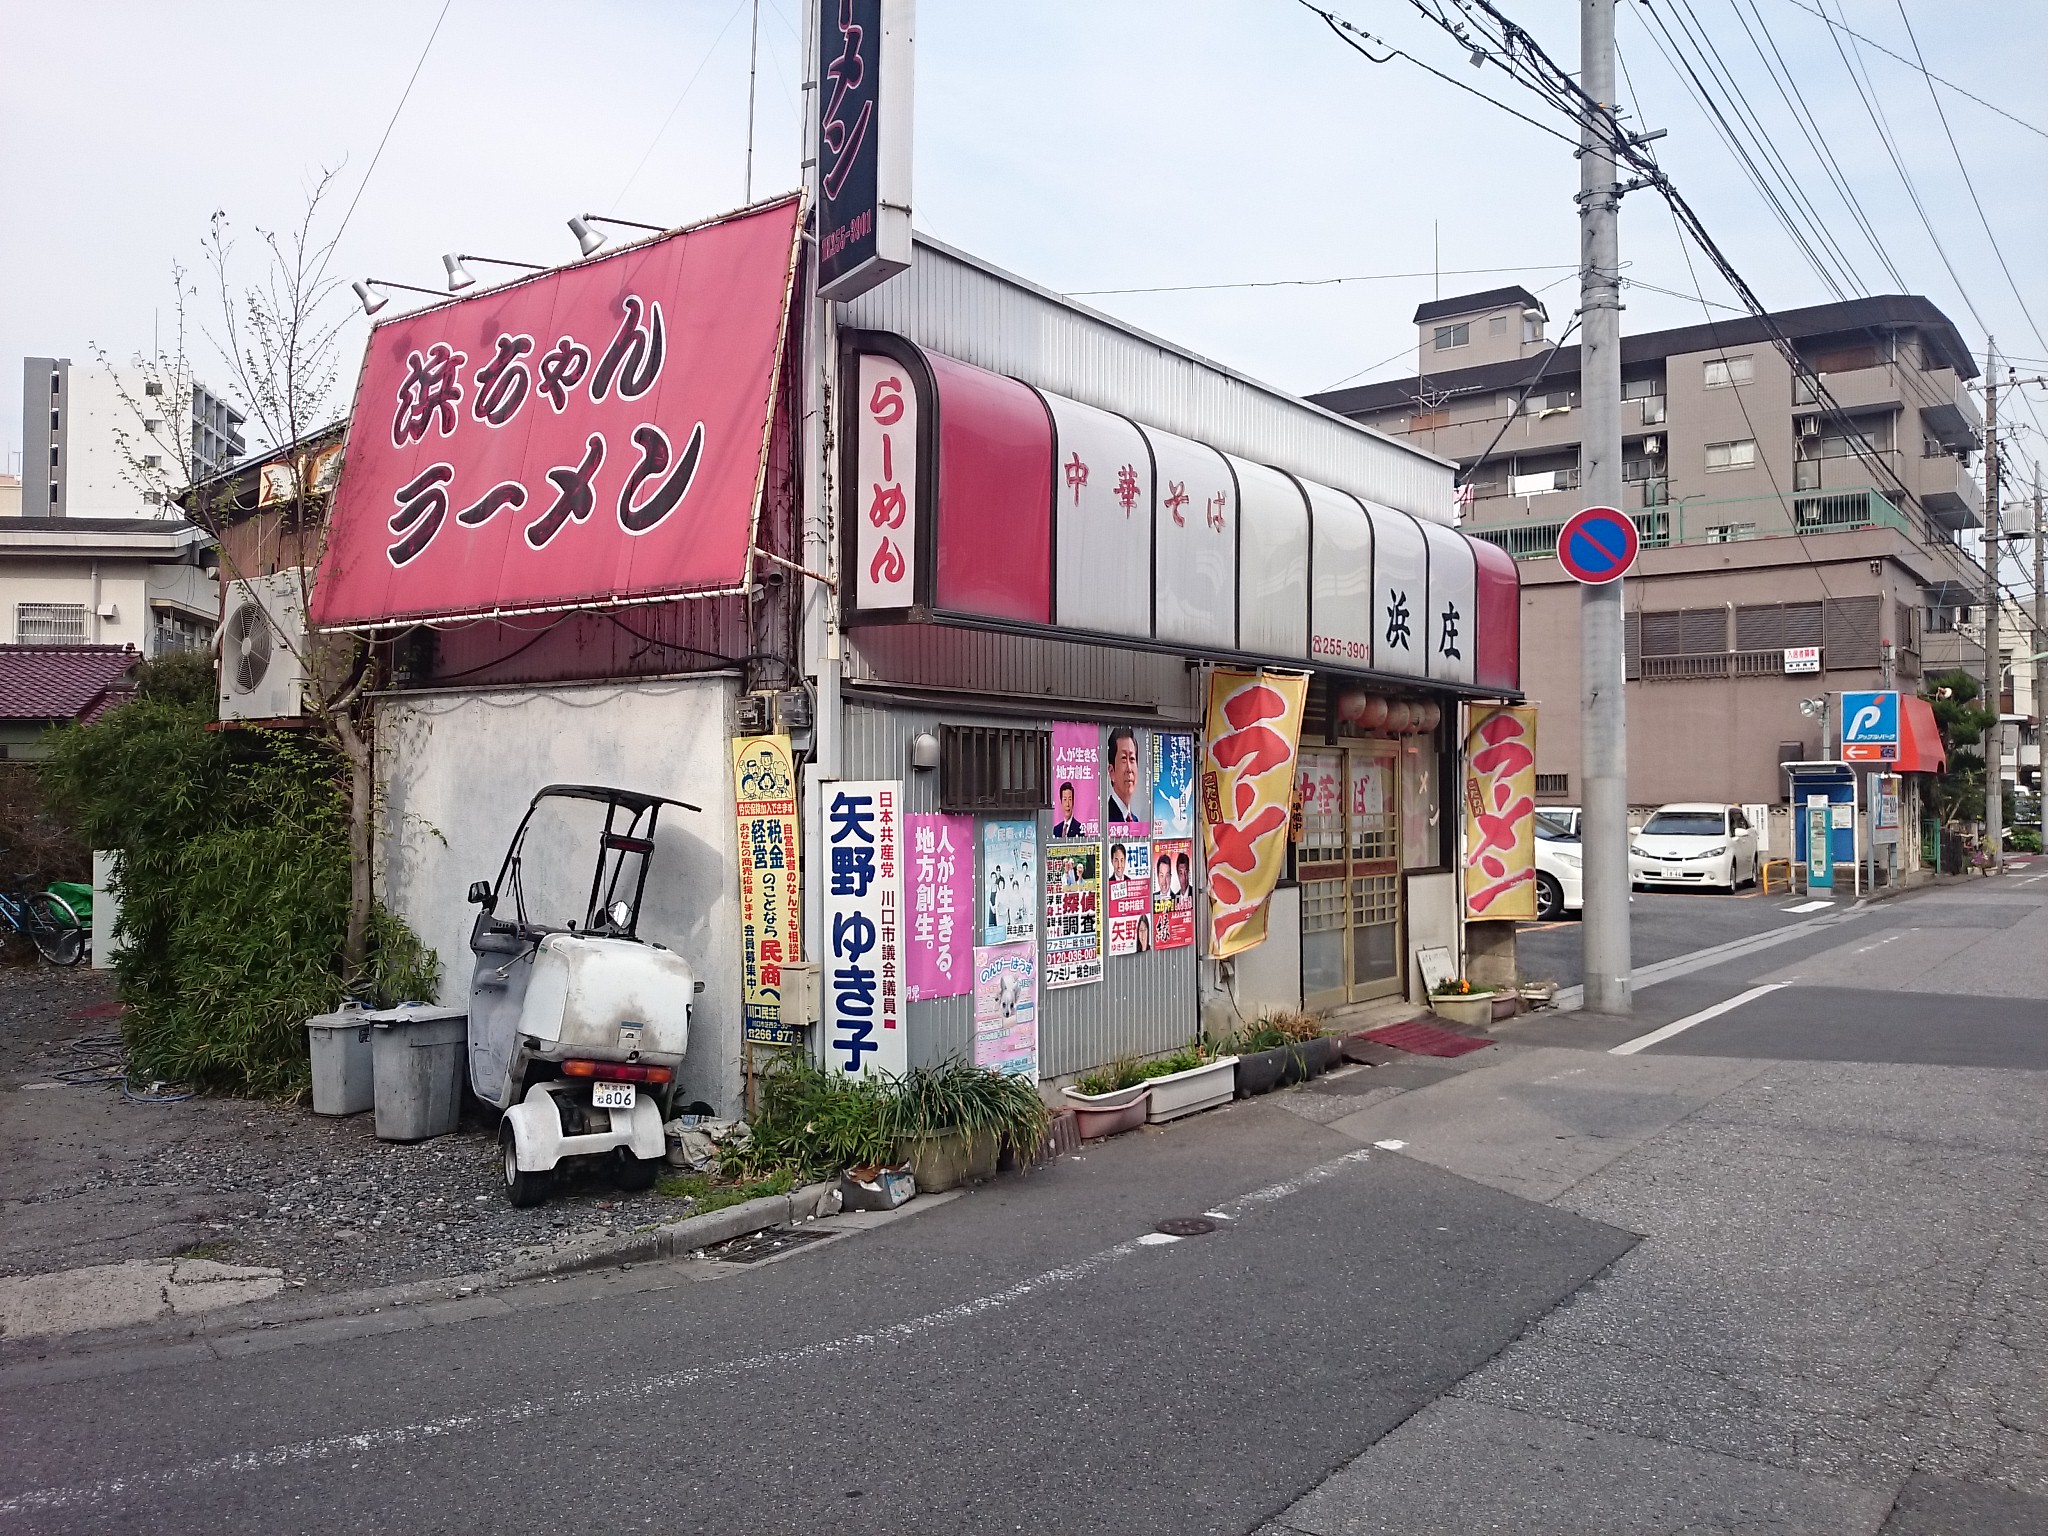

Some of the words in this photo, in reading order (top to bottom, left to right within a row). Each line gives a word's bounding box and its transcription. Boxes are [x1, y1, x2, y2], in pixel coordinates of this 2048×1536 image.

[391, 294, 666, 448] 浜ちゃん
[387, 421, 705, 568] ラーメン
[868, 375, 907, 585] らーめん
[1063, 450, 1228, 534] 中華そば
[1386, 588, 1461, 660] 浜庄
[1056, 765, 1094, 780] 地方創生。
[1170, 736, 1179, 787] させない
[1204, 773, 1222, 824] こだわり
[1468, 714, 1535, 914] ラーメン
[751, 819, 768, 869] 経営
[767, 818, 785, 869] 税金
[829, 791, 876, 898] 矢野
[879, 791, 895, 879] 日本共産党
[1079, 821, 1099, 835] 公明党
[1109, 826, 1130, 837] 公明党
[1127, 846, 1149, 868] 村岡
[914, 825, 937, 951] 地方創生。
[1063, 892, 1096, 914] 探偵
[1118, 899, 1145, 913] 日本共産党
[1063, 914, 1096, 936] 調査
[1112, 920, 1137, 943] 矢野
[881, 890, 897, 1015] 川口市議会議員
[748, 1005, 781, 1021] 川口民主
[832, 910, 879, 1073] ゆき子
[605, 1092, 632, 1106] 806
